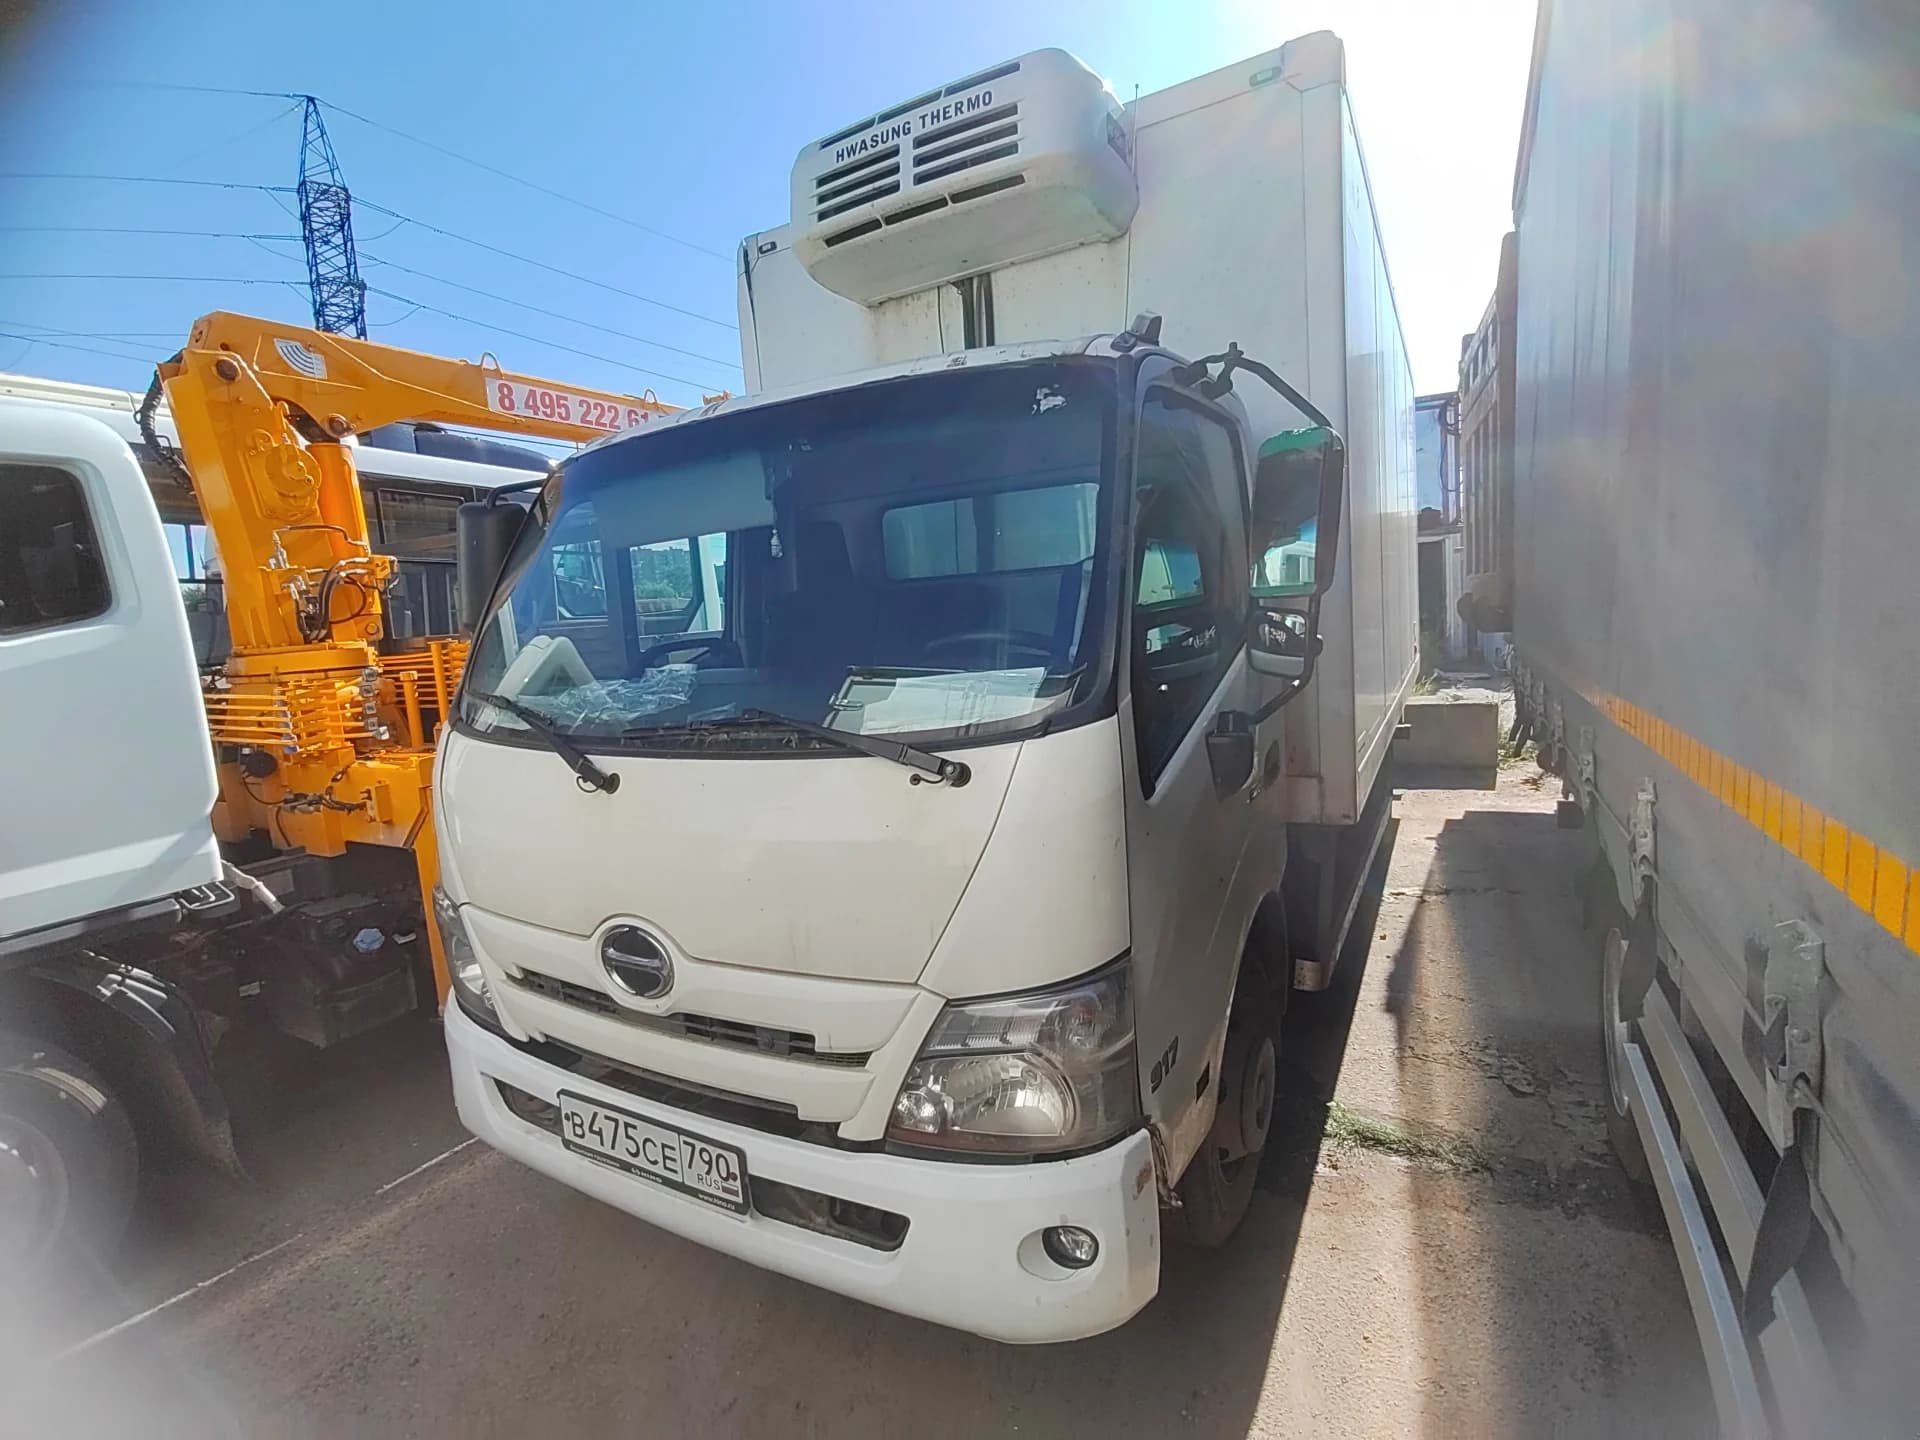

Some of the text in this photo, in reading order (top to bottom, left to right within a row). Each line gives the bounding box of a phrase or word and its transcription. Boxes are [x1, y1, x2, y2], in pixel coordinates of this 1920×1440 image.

[835, 90, 993, 164] HWASUNG THERMO
[497, 382, 515, 411] 8
[524, 388, 571, 422] 495
[578, 398, 621, 430] 222
[1150, 1035, 1179, 1095] 917
[682, 1139, 731, 1182] 790
[696, 1173, 721, 1191] RUS
